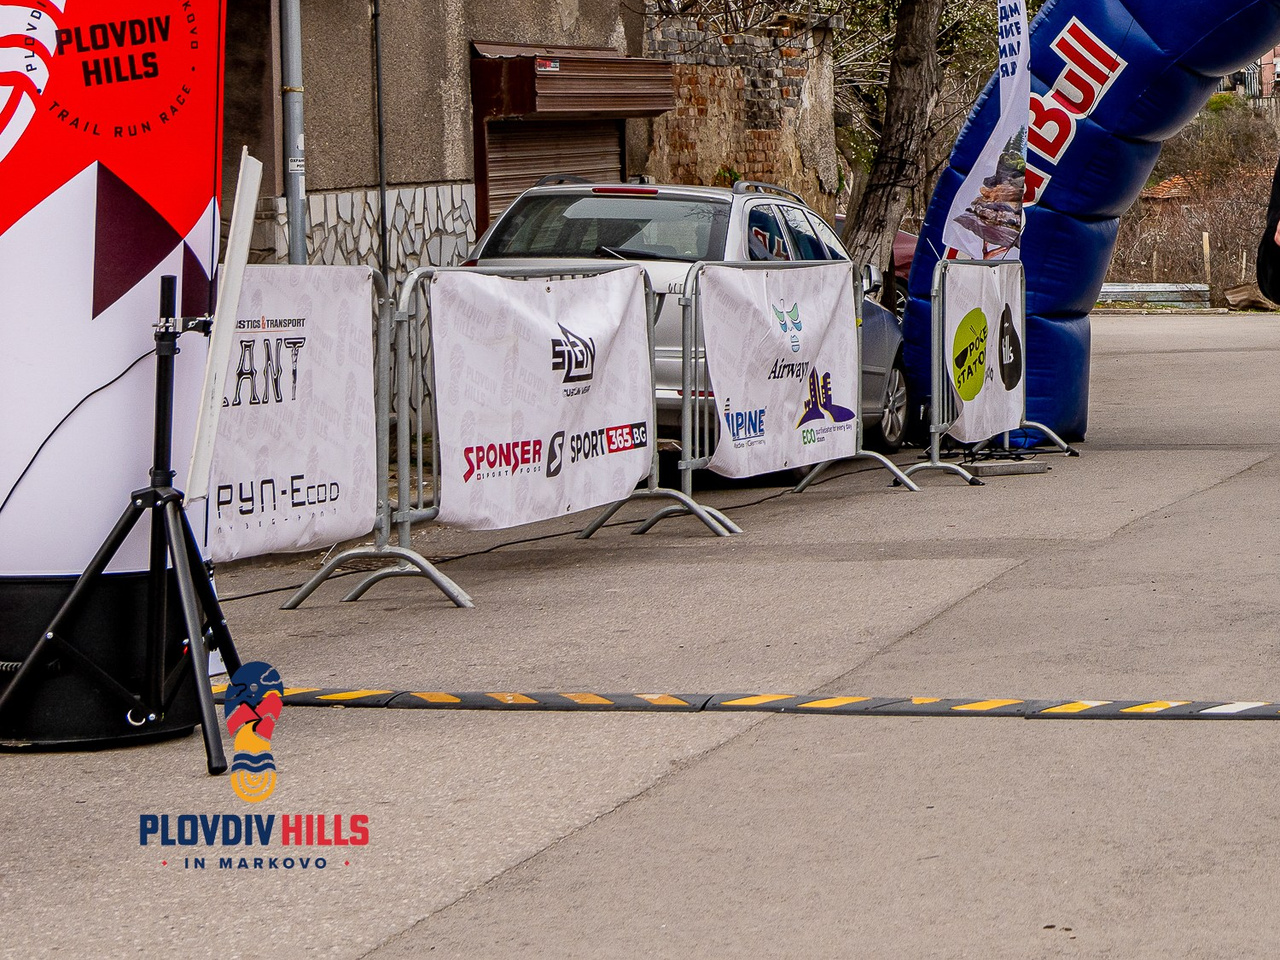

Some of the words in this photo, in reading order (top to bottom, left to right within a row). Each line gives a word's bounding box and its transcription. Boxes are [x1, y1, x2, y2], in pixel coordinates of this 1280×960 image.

[55, 15, 170, 55] PLOVDIV
[82, 52, 158, 87] HILLS
[49, 101, 100, 136] TRAIL
[114, 121, 151, 137] RUN
[159, 85, 191, 124] RACE
[463, 440, 543, 483] SPONSER
